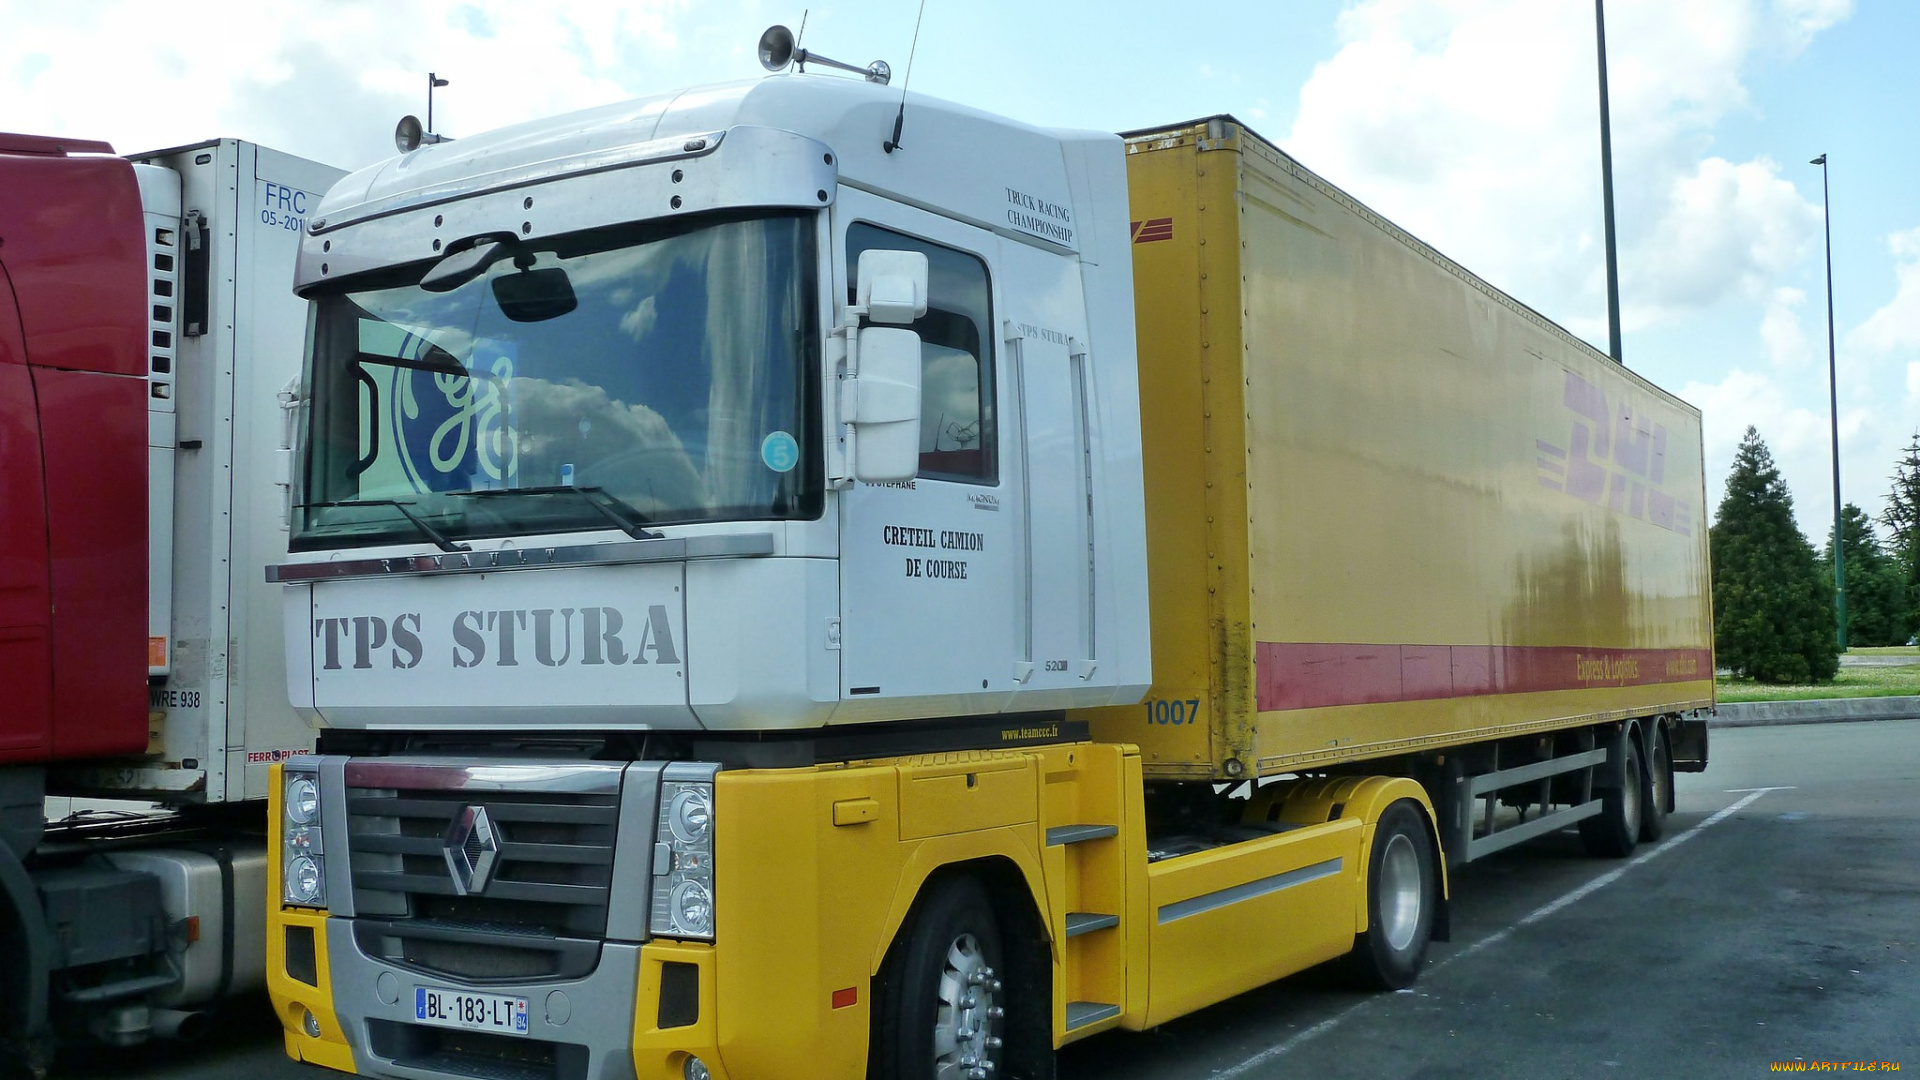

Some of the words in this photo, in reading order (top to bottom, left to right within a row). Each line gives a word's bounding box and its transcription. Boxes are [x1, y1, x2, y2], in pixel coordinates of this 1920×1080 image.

[266, 182, 306, 214] FRC
[1005, 187, 1036, 211] TRUCK
[1038, 199, 1070, 222] RACING
[1007, 209, 1073, 243] CHAMPIONSHIP
[1019, 323, 1038, 339] TPS
[1041, 328, 1070, 346] STURA
[1562, 371, 1677, 531] DHL
[883, 525, 936, 548] CRETEIL
[940, 530, 984, 551] CAMION
[906, 558, 921, 577] DE
[926, 559, 967, 580] COURSE
[315, 612, 423, 670] TPS
[452, 604, 681, 668] STURA
[180, 691, 200, 708] 938
[1144, 699, 1200, 725] 1007
[1001, 724, 1058, 741] www.teamccc.fr
